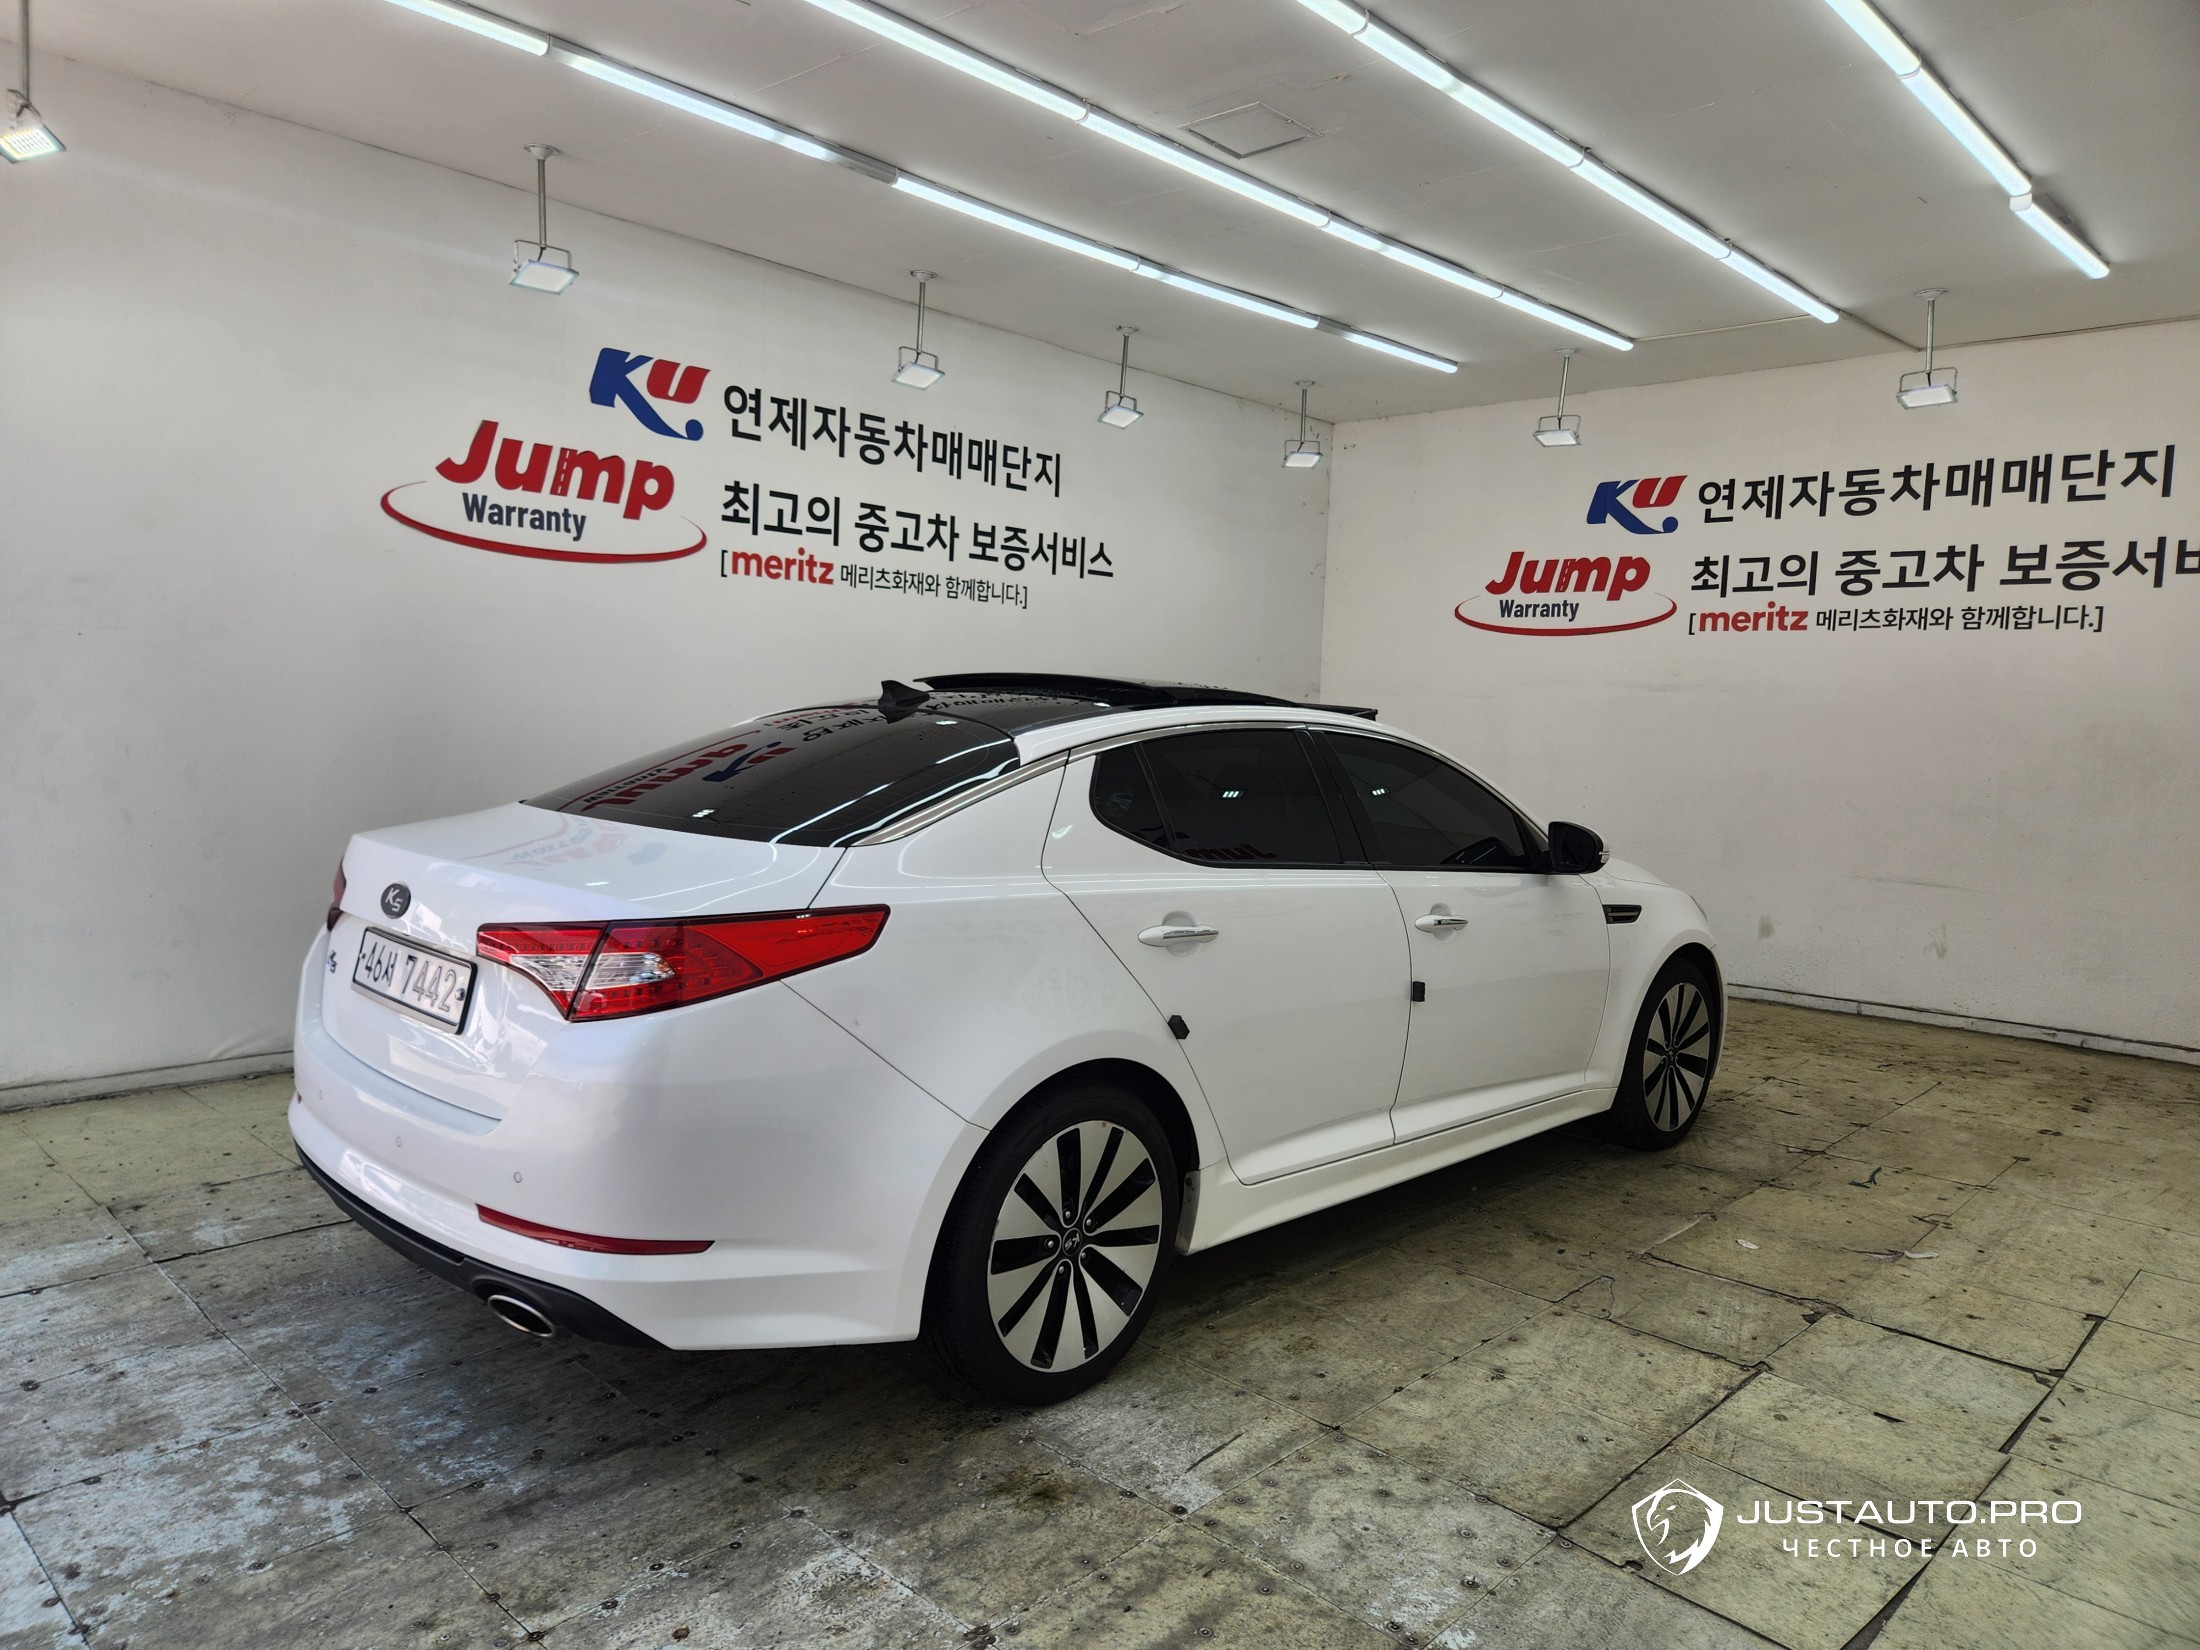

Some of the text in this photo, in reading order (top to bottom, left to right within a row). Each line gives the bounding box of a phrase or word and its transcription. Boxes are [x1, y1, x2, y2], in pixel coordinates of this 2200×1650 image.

[724, 385, 1061, 497] 연제자동차매매단지
[435, 420, 675, 520] Jump
[1698, 444, 2175, 523] 연제자동차매매단지
[462, 492, 587, 541] Warranty
[721, 481, 1114, 579] 최고의 중고차 보증서비스
[840, 563, 941, 597] 메리츠화재와
[1485, 551, 1650, 601] Jump
[1691, 551, 1818, 597] 최고의
[1835, 543, 1984, 596] 중고차
[1500, 599, 1579, 622] Warranty
[1815, 607, 1953, 631] 메리츠화재와
[402, 954, 456, 1012] 7442
